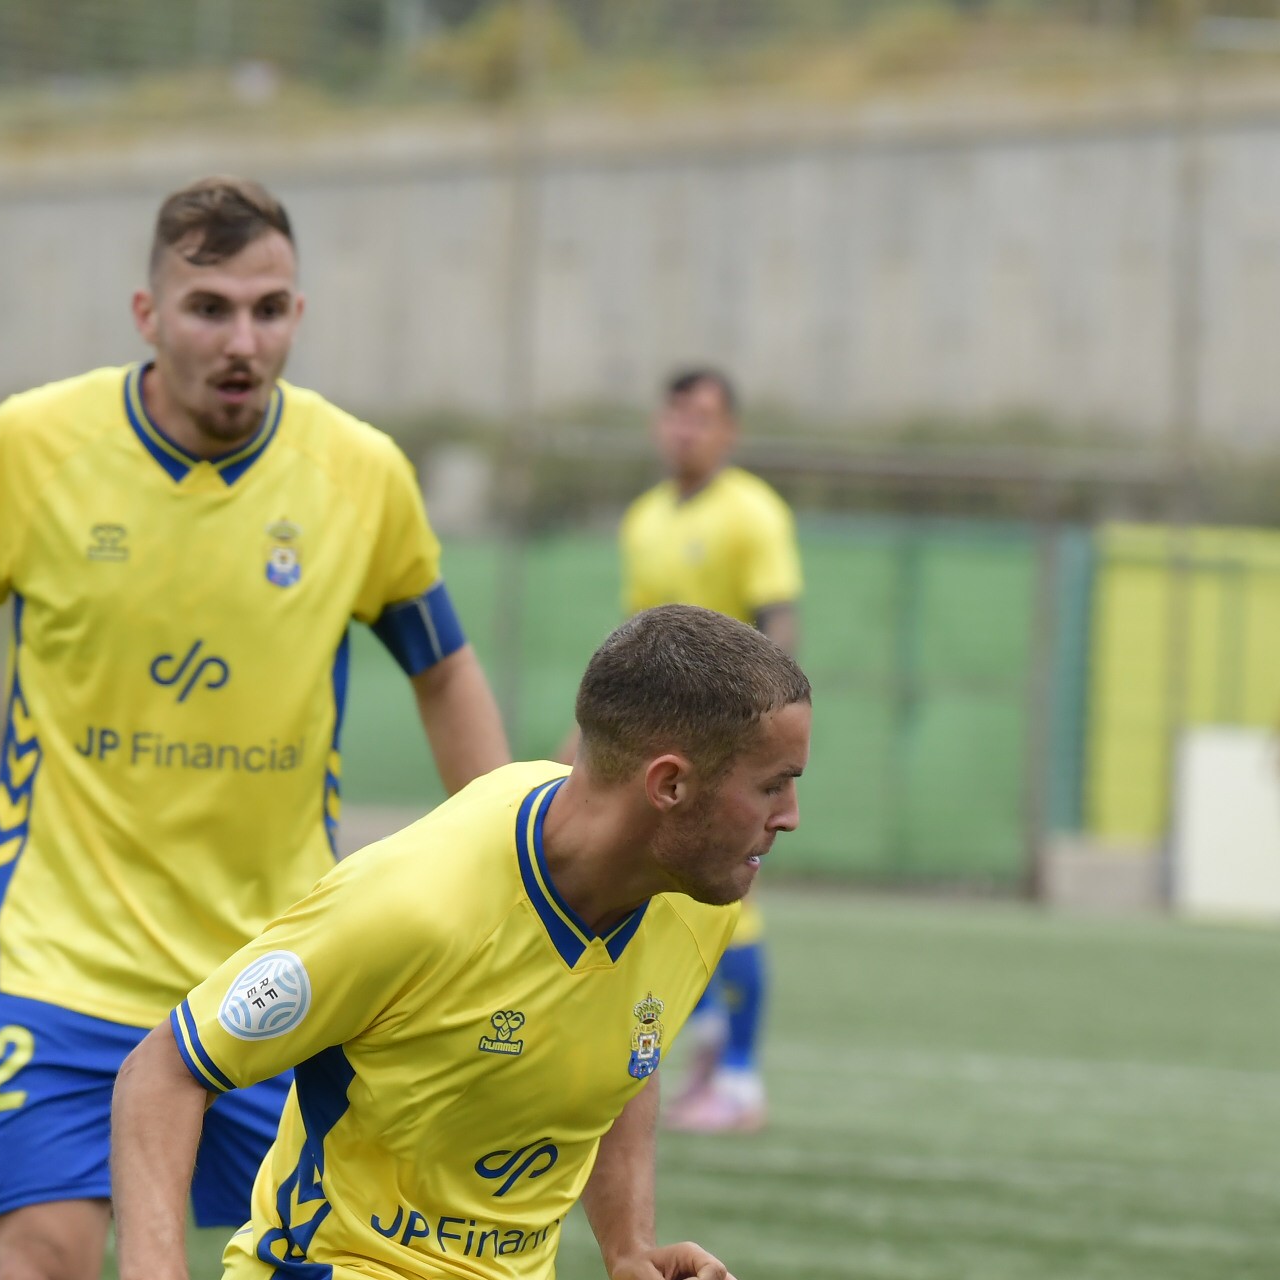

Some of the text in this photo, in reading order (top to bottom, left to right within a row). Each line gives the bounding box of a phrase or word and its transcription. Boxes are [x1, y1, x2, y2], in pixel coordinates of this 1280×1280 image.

[75, 727, 305, 773] JP Financial
[480, 1037, 522, 1054] hummel
[370, 1204, 430, 1247] JP
